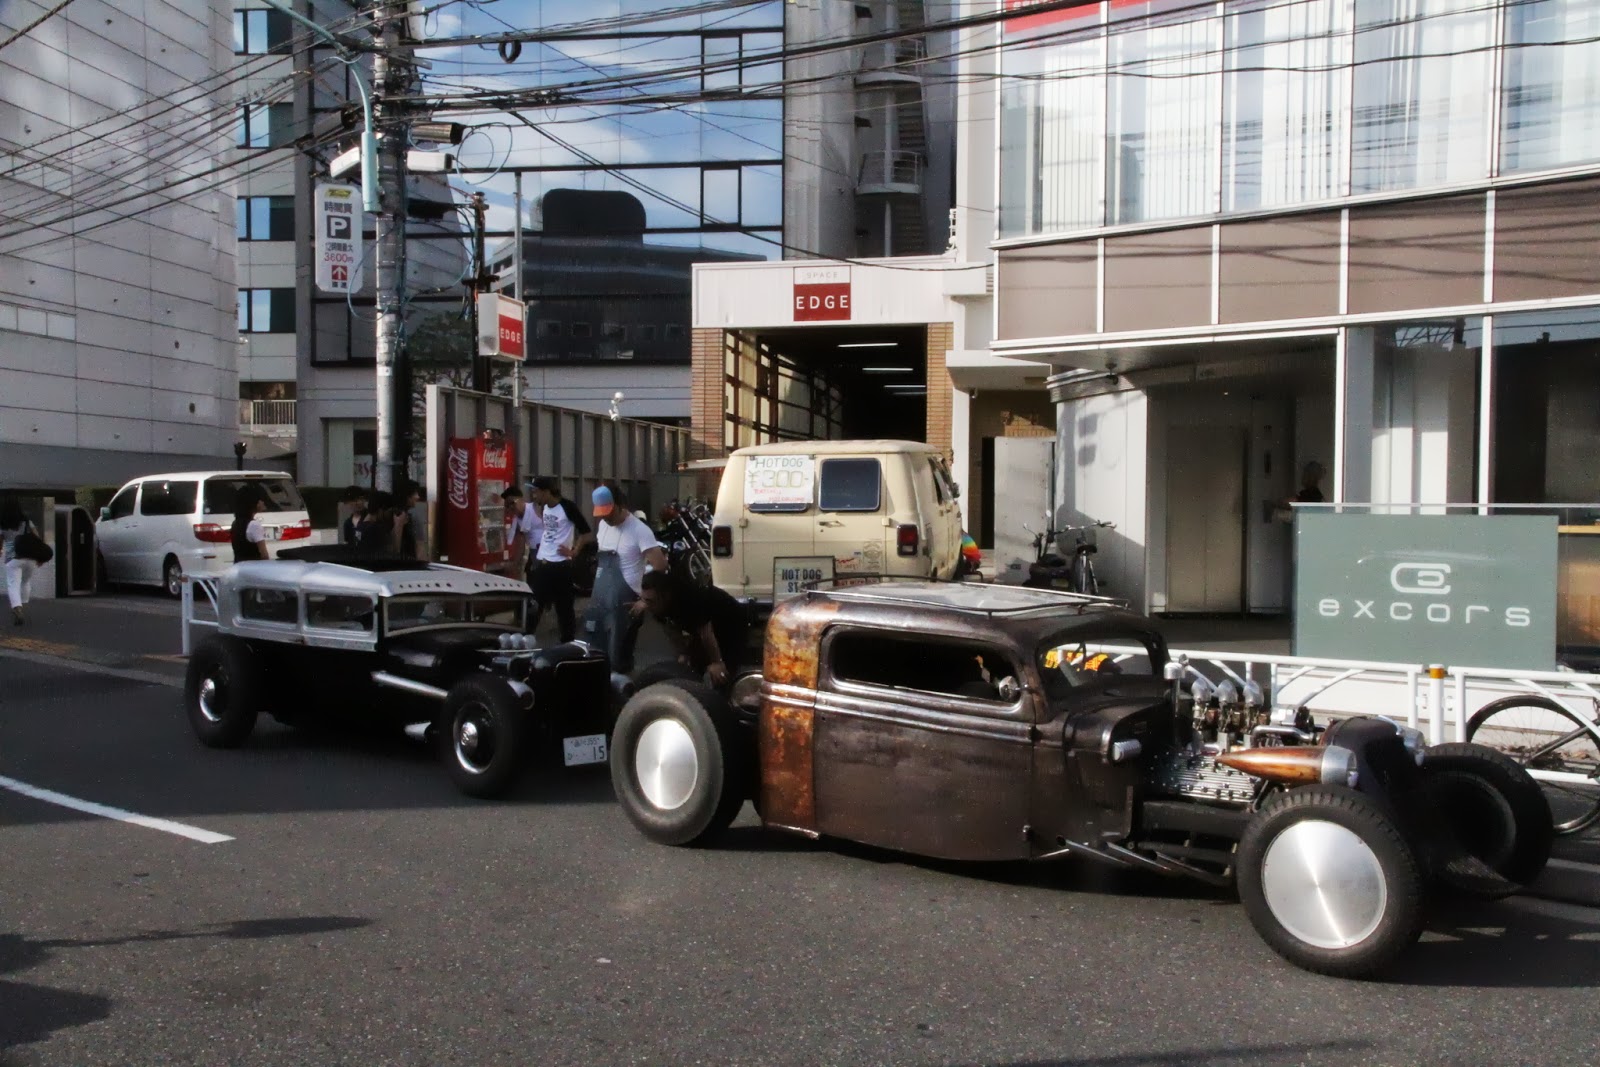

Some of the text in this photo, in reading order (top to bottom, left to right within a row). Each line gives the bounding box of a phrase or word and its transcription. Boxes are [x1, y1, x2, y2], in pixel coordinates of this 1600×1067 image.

[330, 217, 348, 237] P
[806, 271, 839, 279] SPACE
[796, 295, 849, 310] EDGE
[500, 327, 521, 344] EDGE
[755, 457, 804, 468] HOT DOG
[781, 568, 822, 581] HOT DOG
[1318, 598, 1530, 627] excors
